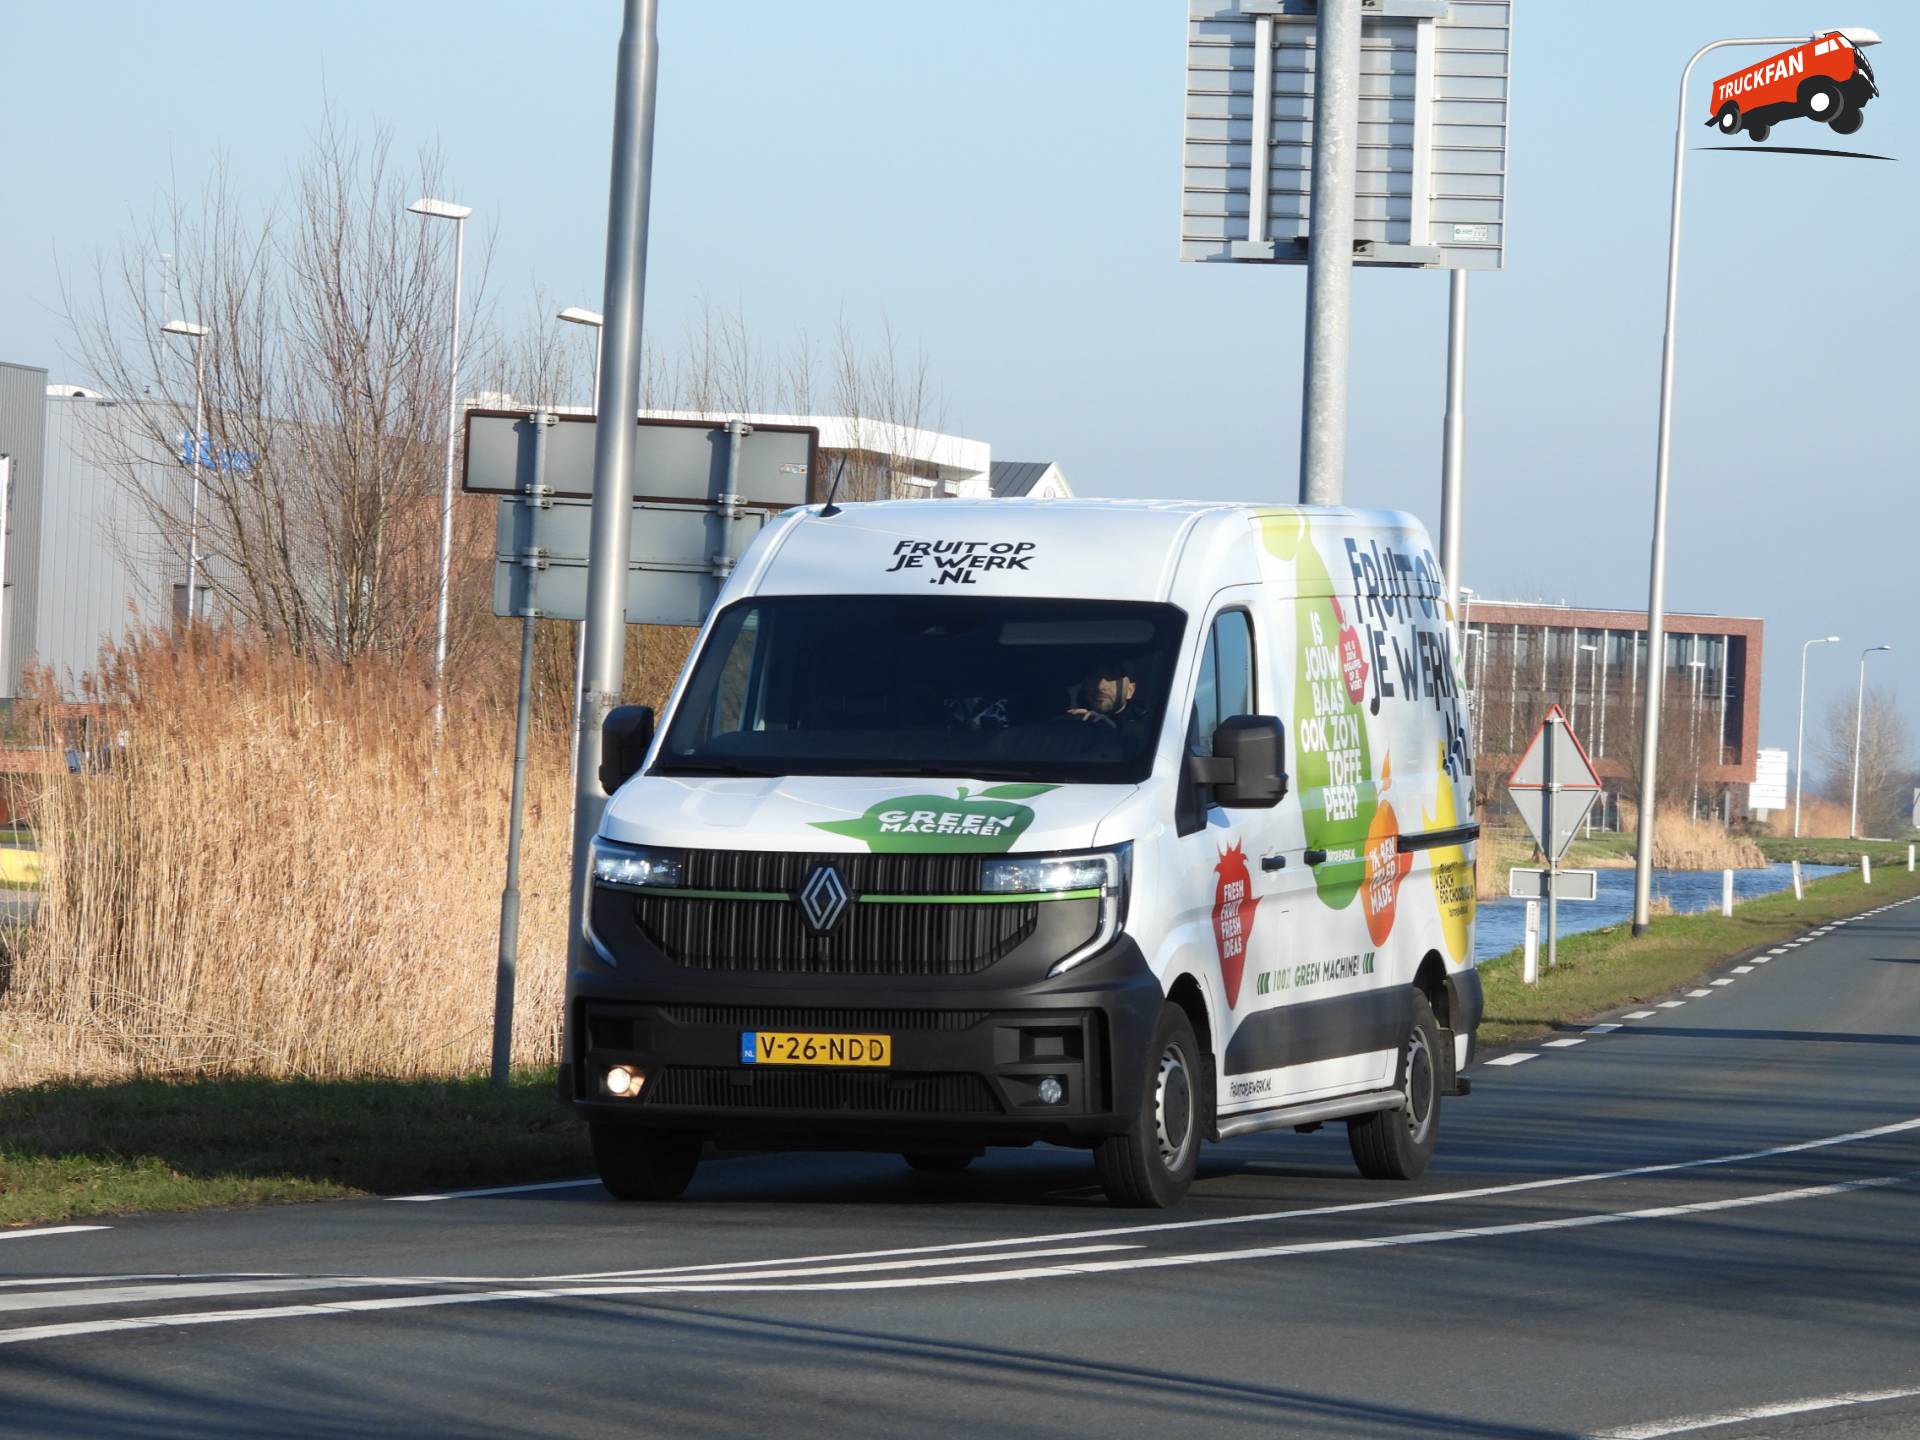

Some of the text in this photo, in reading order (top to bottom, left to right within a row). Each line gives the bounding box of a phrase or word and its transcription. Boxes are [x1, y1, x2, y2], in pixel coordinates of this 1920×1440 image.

[885, 554, 1036, 572] JE WERK
[893, 540, 1036, 555] FRUIT OP
[929, 568, 976, 585] .NL
[1344, 538, 1441, 631] FRUIT OP
[1309, 611, 1323, 646] IS
[1304, 645, 1339, 681] JOUW
[1366, 623, 1394, 716] JE
[1391, 624, 1459, 711] WERK
[1312, 680, 1345, 717] BAAS
[1300, 714, 1360, 753] OOK ZO'N
[1326, 748, 1362, 787] TOFFE
[878, 811, 1015, 827] GREEN
[1322, 784, 1358, 822] PEER?
[880, 823, 1001, 836] MACHINE!
[1223, 880, 1244, 902] FRESH
[1295, 963, 1320, 987] GREEN
[1323, 955, 1360, 981] MACHINE!
[744, 1036, 884, 1061] NL V-26-NDD
